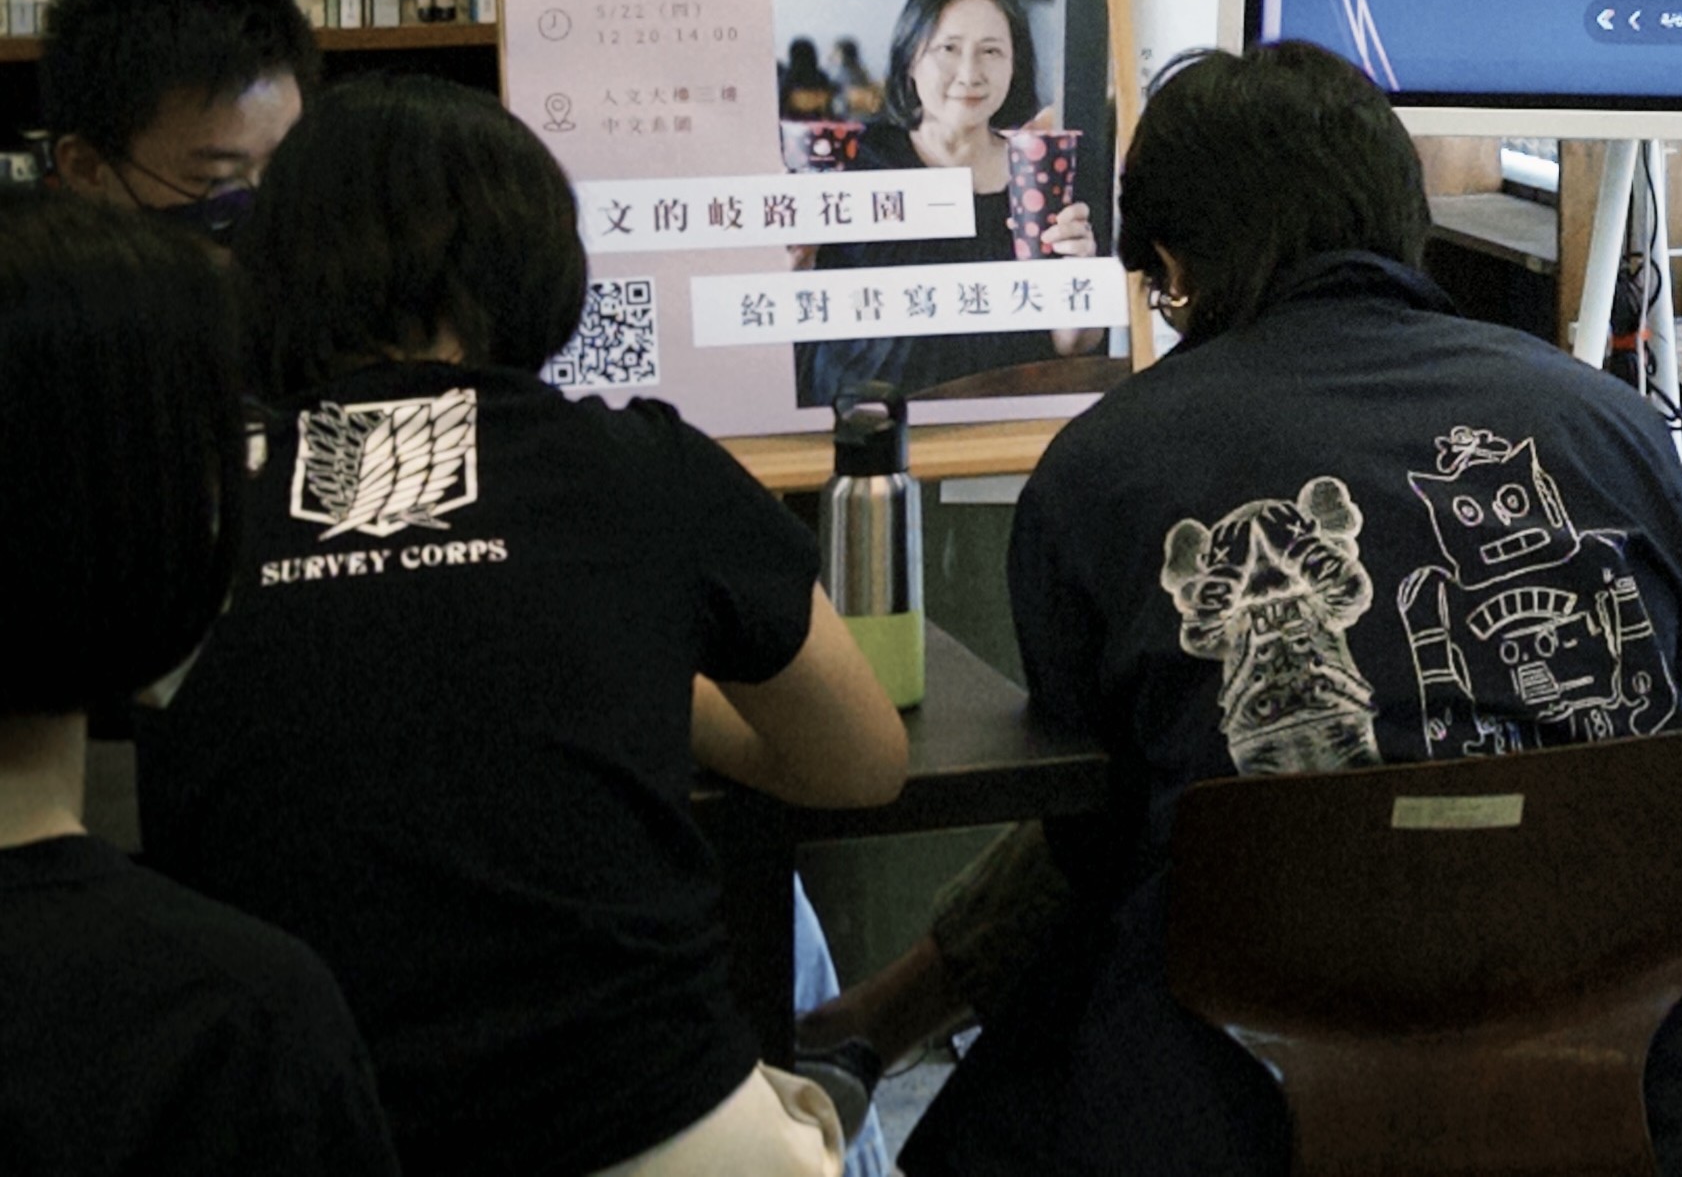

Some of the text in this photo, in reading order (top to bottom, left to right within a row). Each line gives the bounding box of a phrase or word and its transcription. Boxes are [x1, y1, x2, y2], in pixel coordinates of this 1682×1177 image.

[739, 278, 1097, 327] 給對書寫迷失者
[261, 538, 509, 586] SURVEY CORPS
